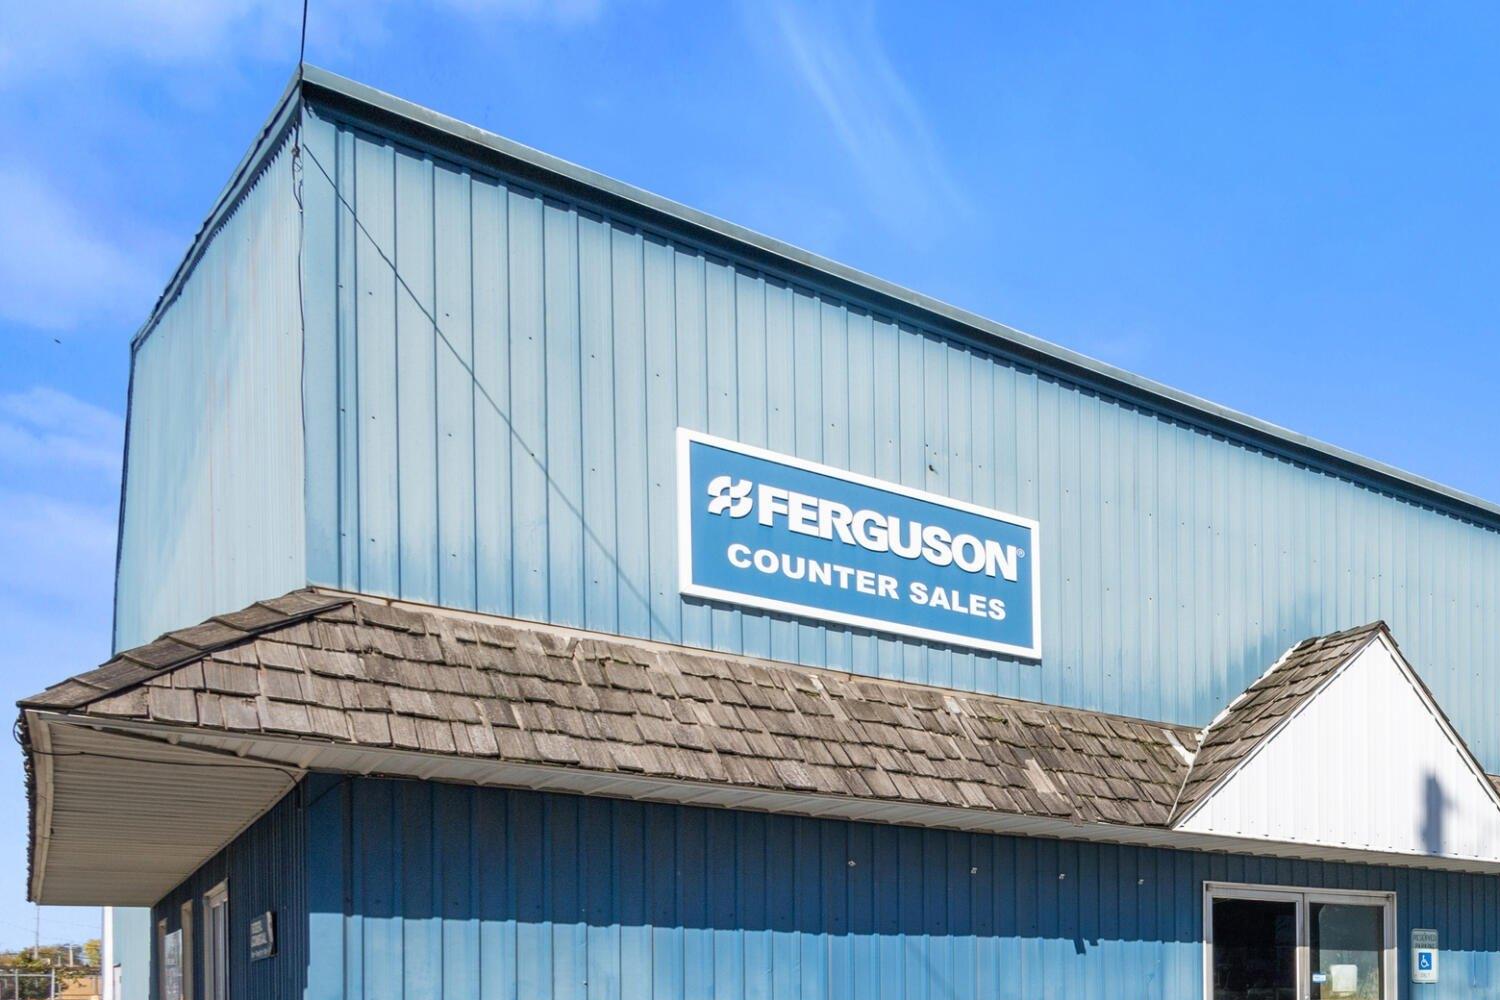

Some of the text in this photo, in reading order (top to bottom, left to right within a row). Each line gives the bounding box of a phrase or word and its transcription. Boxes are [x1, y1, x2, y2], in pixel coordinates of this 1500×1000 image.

[758, 483, 1018, 582] FERGUSON
[727, 543, 1006, 621] COUNTER SALES
